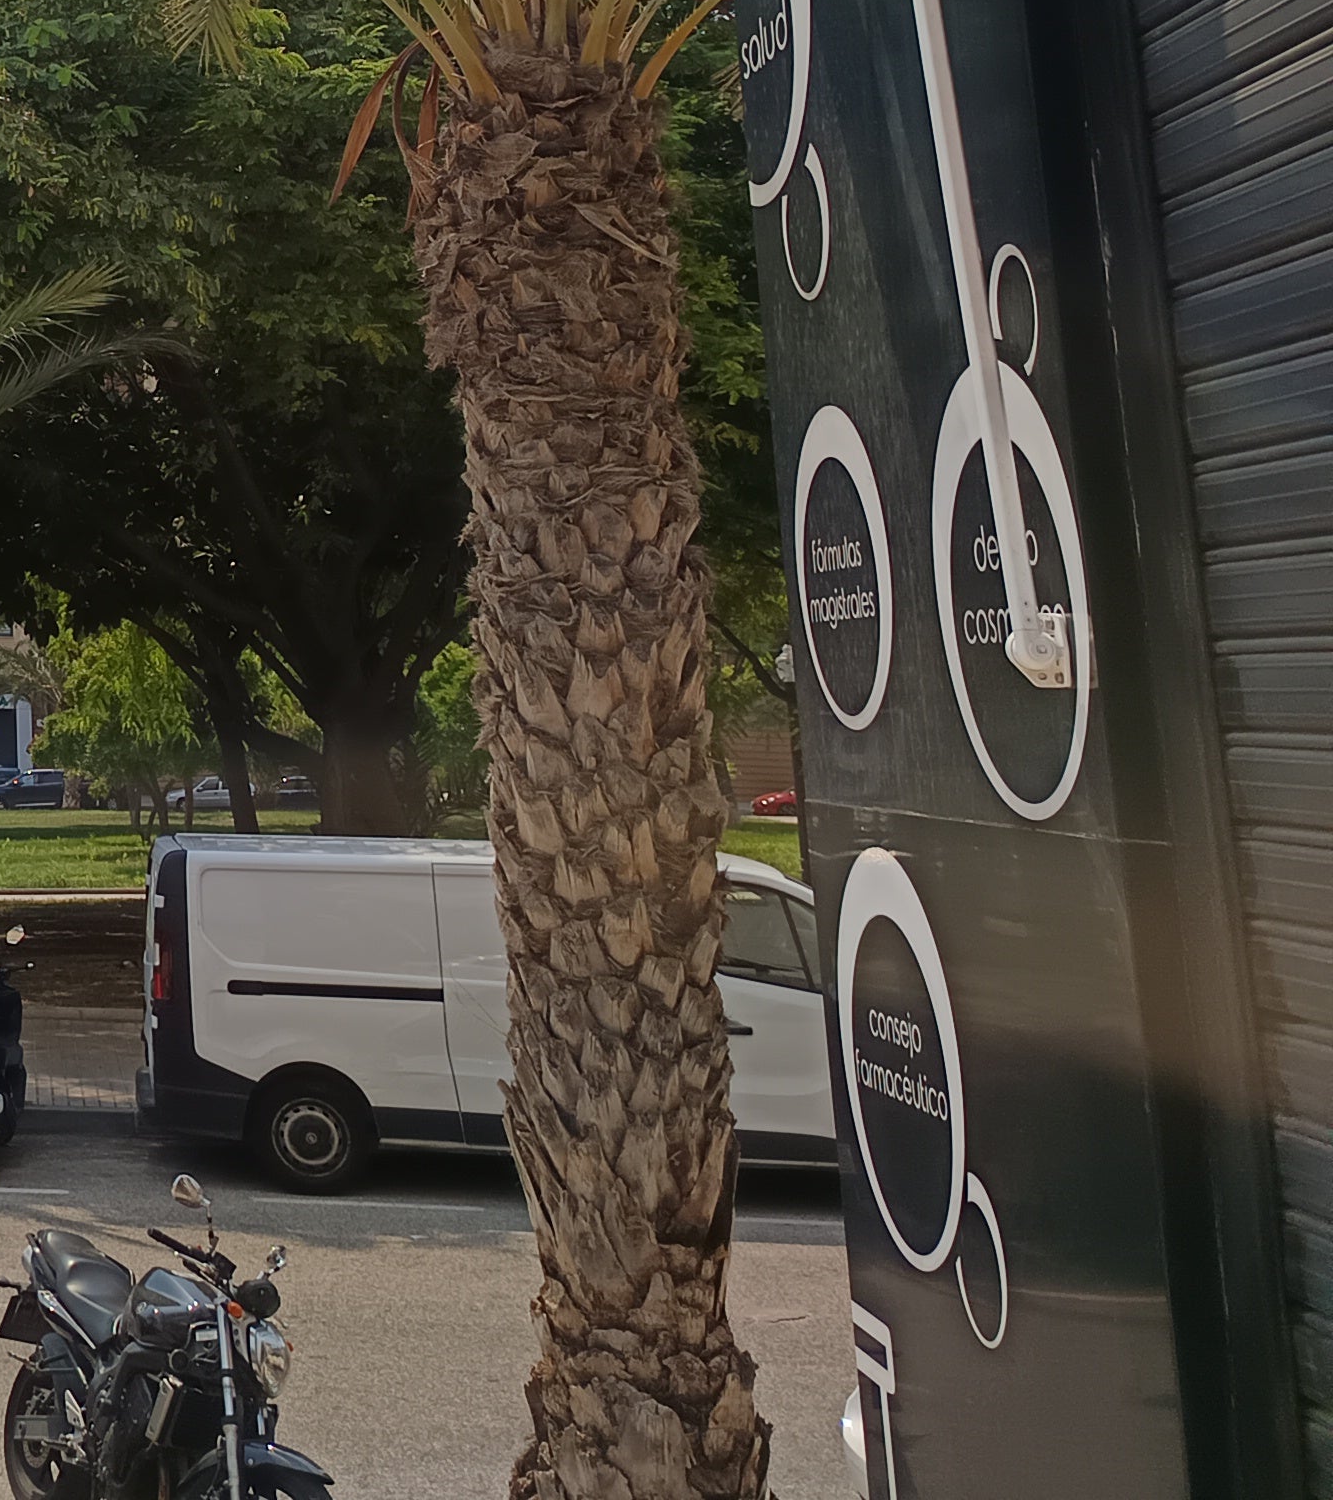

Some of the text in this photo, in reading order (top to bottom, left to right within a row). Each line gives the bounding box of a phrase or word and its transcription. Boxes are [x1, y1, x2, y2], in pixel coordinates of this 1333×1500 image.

[811, 535, 863, 574] fórmulas
[974, 524, 1039, 572] deo
[810, 585, 876, 630] magistrales
[868, 1008, 922, 1059] consejo
[854, 1047, 948, 1121] farmacéutico
